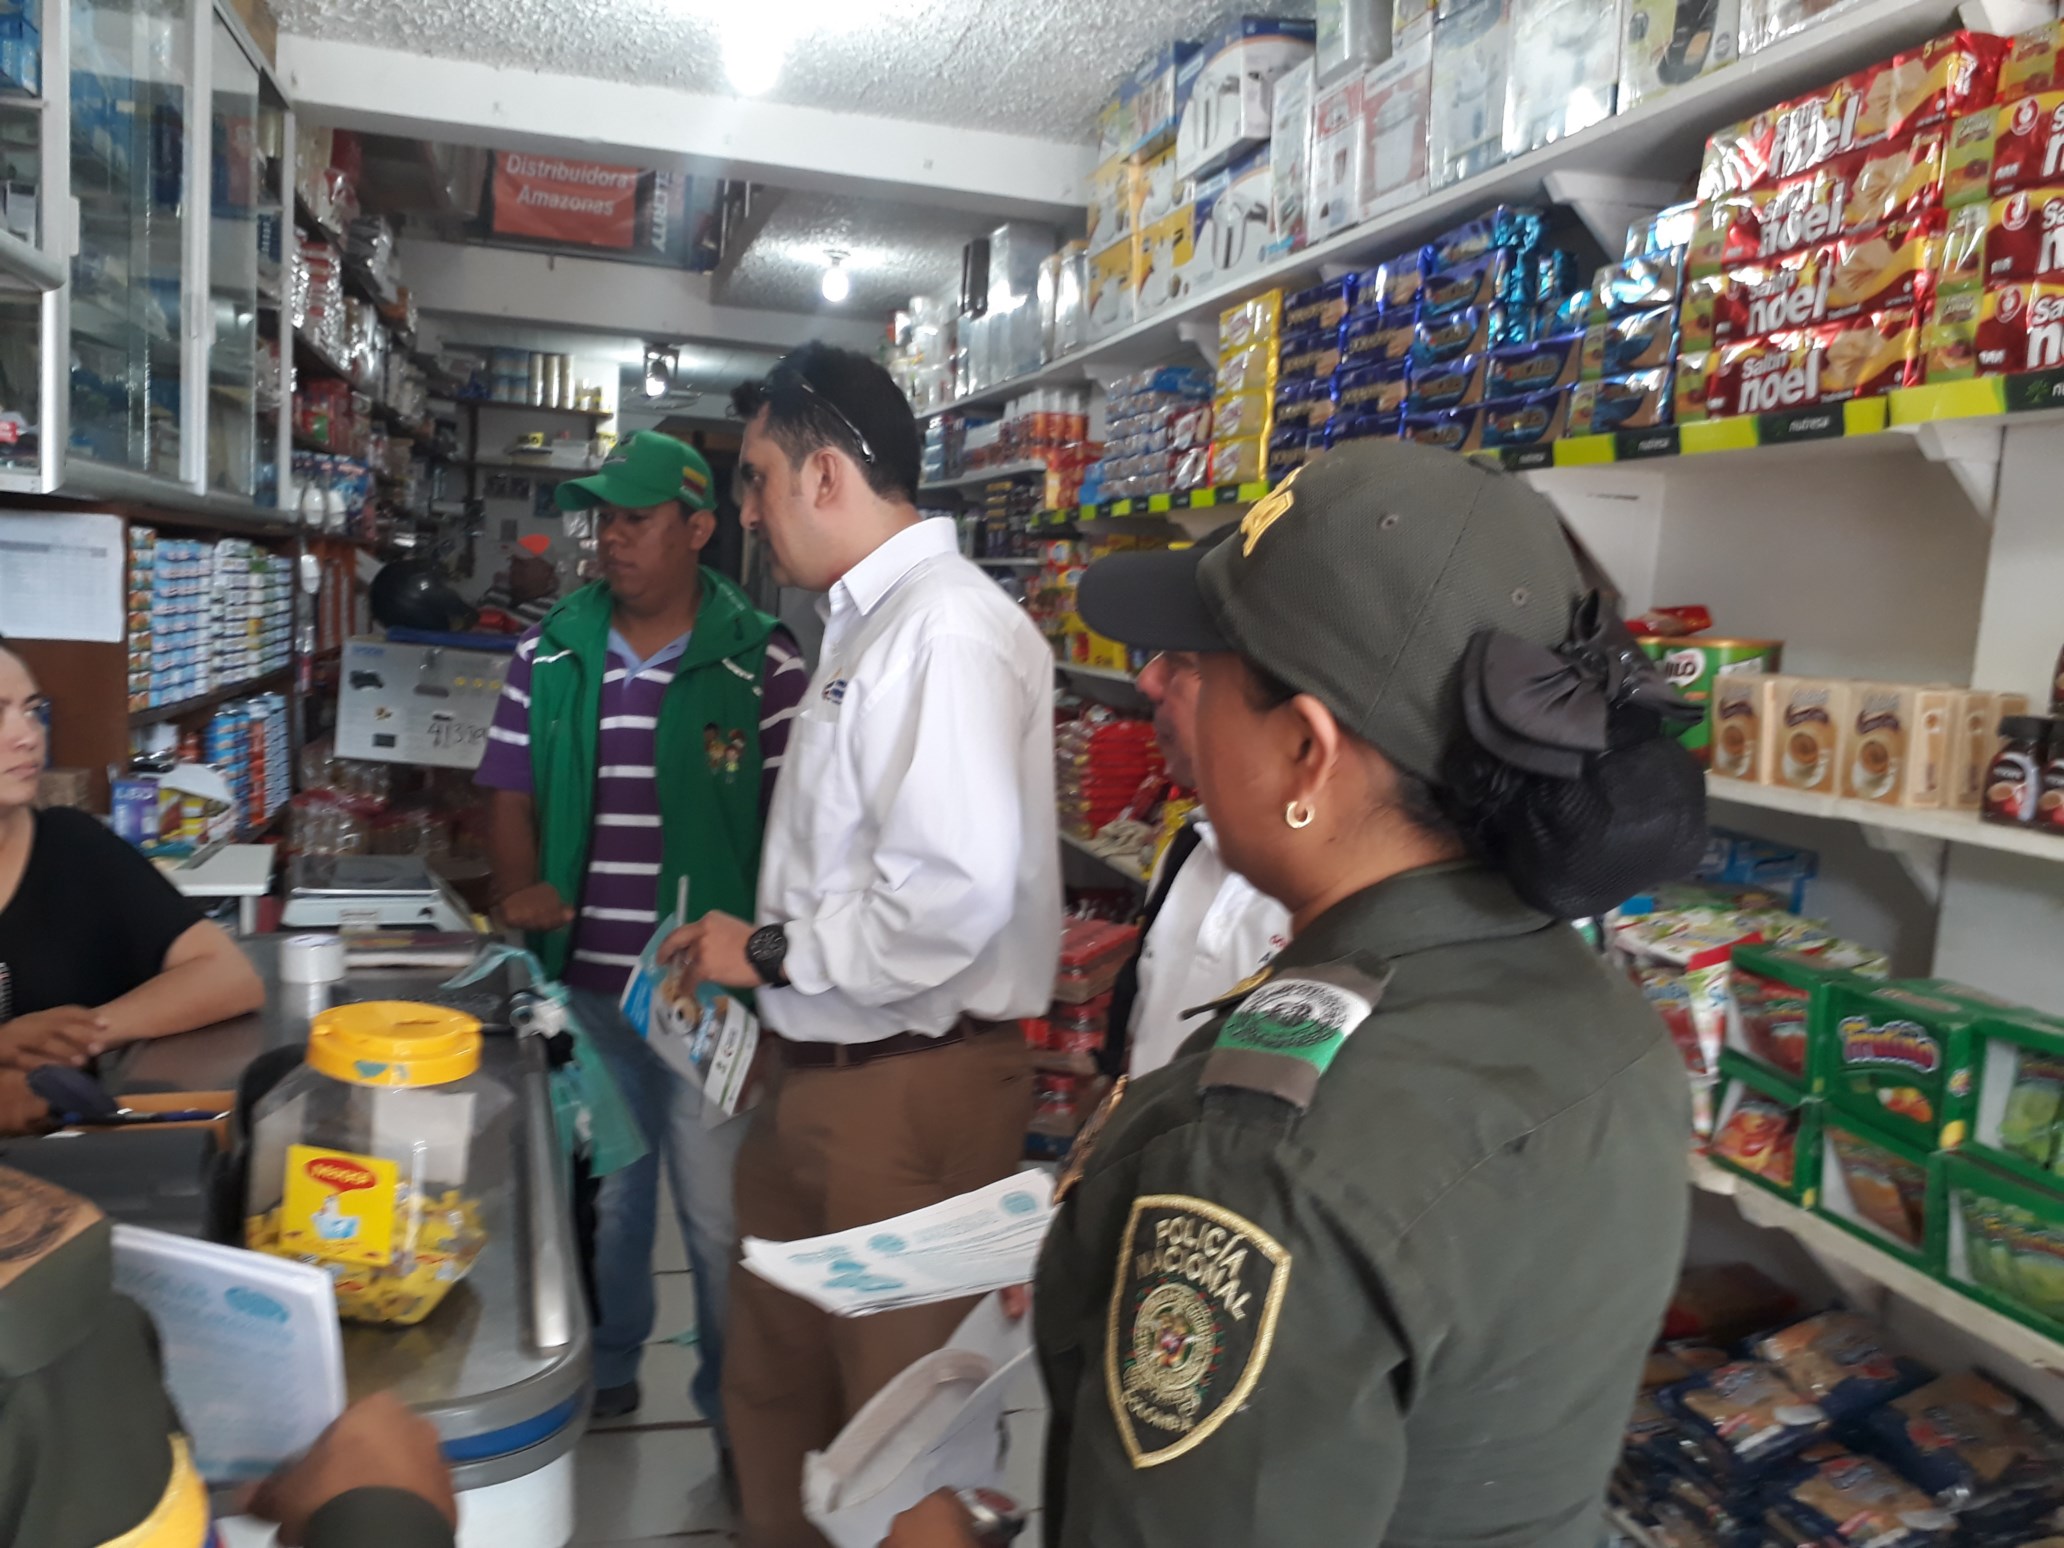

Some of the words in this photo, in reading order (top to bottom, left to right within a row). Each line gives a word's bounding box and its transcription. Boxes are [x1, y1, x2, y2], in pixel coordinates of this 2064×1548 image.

[506, 153, 629, 189] Distribuidora
[516, 184, 615, 216] Amazonas
[1757, 179, 1845, 258] noel
[1747, 262, 1832, 336] noel
[1738, 347, 1820, 413] noel
